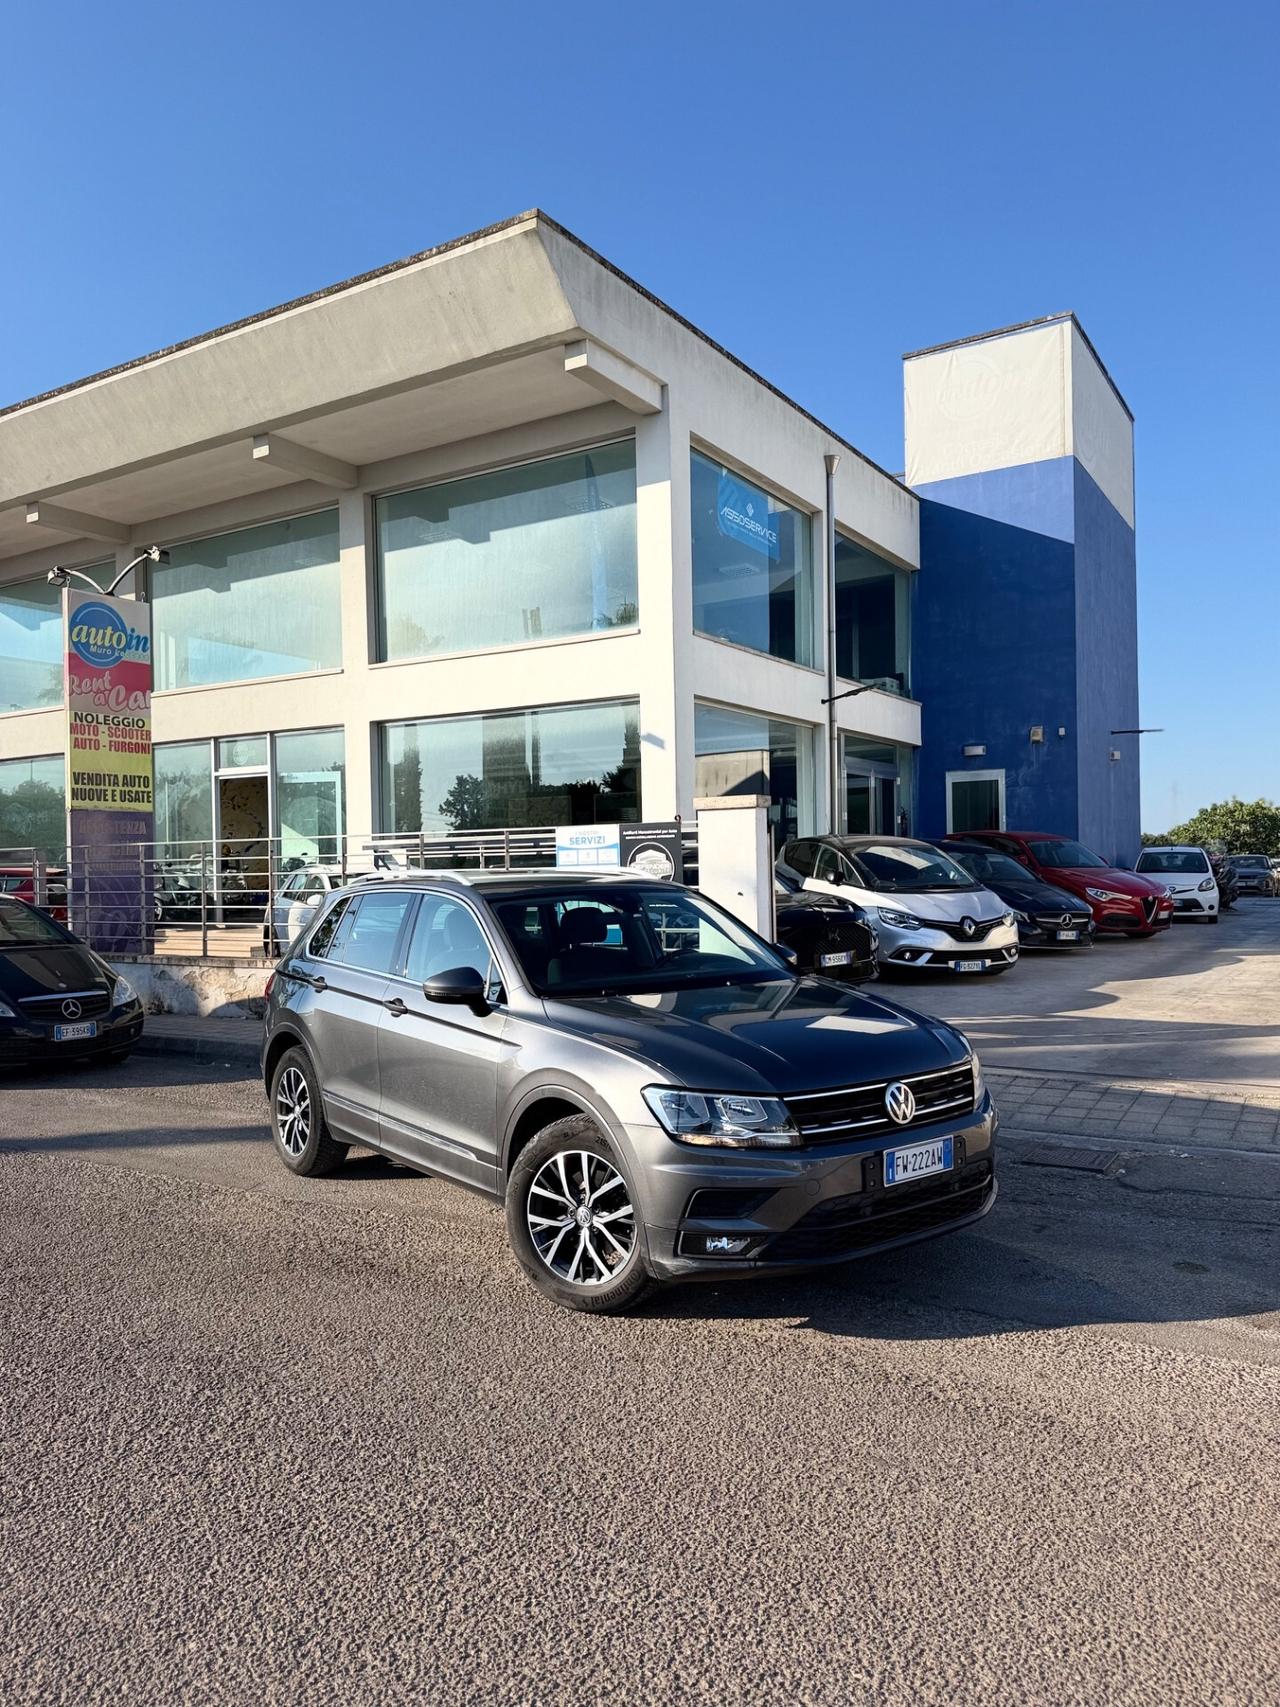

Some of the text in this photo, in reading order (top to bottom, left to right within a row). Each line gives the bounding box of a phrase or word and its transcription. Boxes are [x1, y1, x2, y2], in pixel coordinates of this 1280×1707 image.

[721, 506, 776, 543] ASSOSERVICE
[90, 645, 112, 655] Muro
[70, 671, 111, 696] Rent
[74, 712, 145, 729] NOLEGGIO
[70, 722, 99, 737] MOTO
[107, 726, 151, 741] SCOOTER
[73, 737, 100, 751] AUTO
[108, 740, 151, 755] FURGONI
[73, 771, 150, 789] VENDITA AUTO
[72, 788, 152, 803] NUOVE E USATE
[569, 835, 606, 846] SERVIZI
